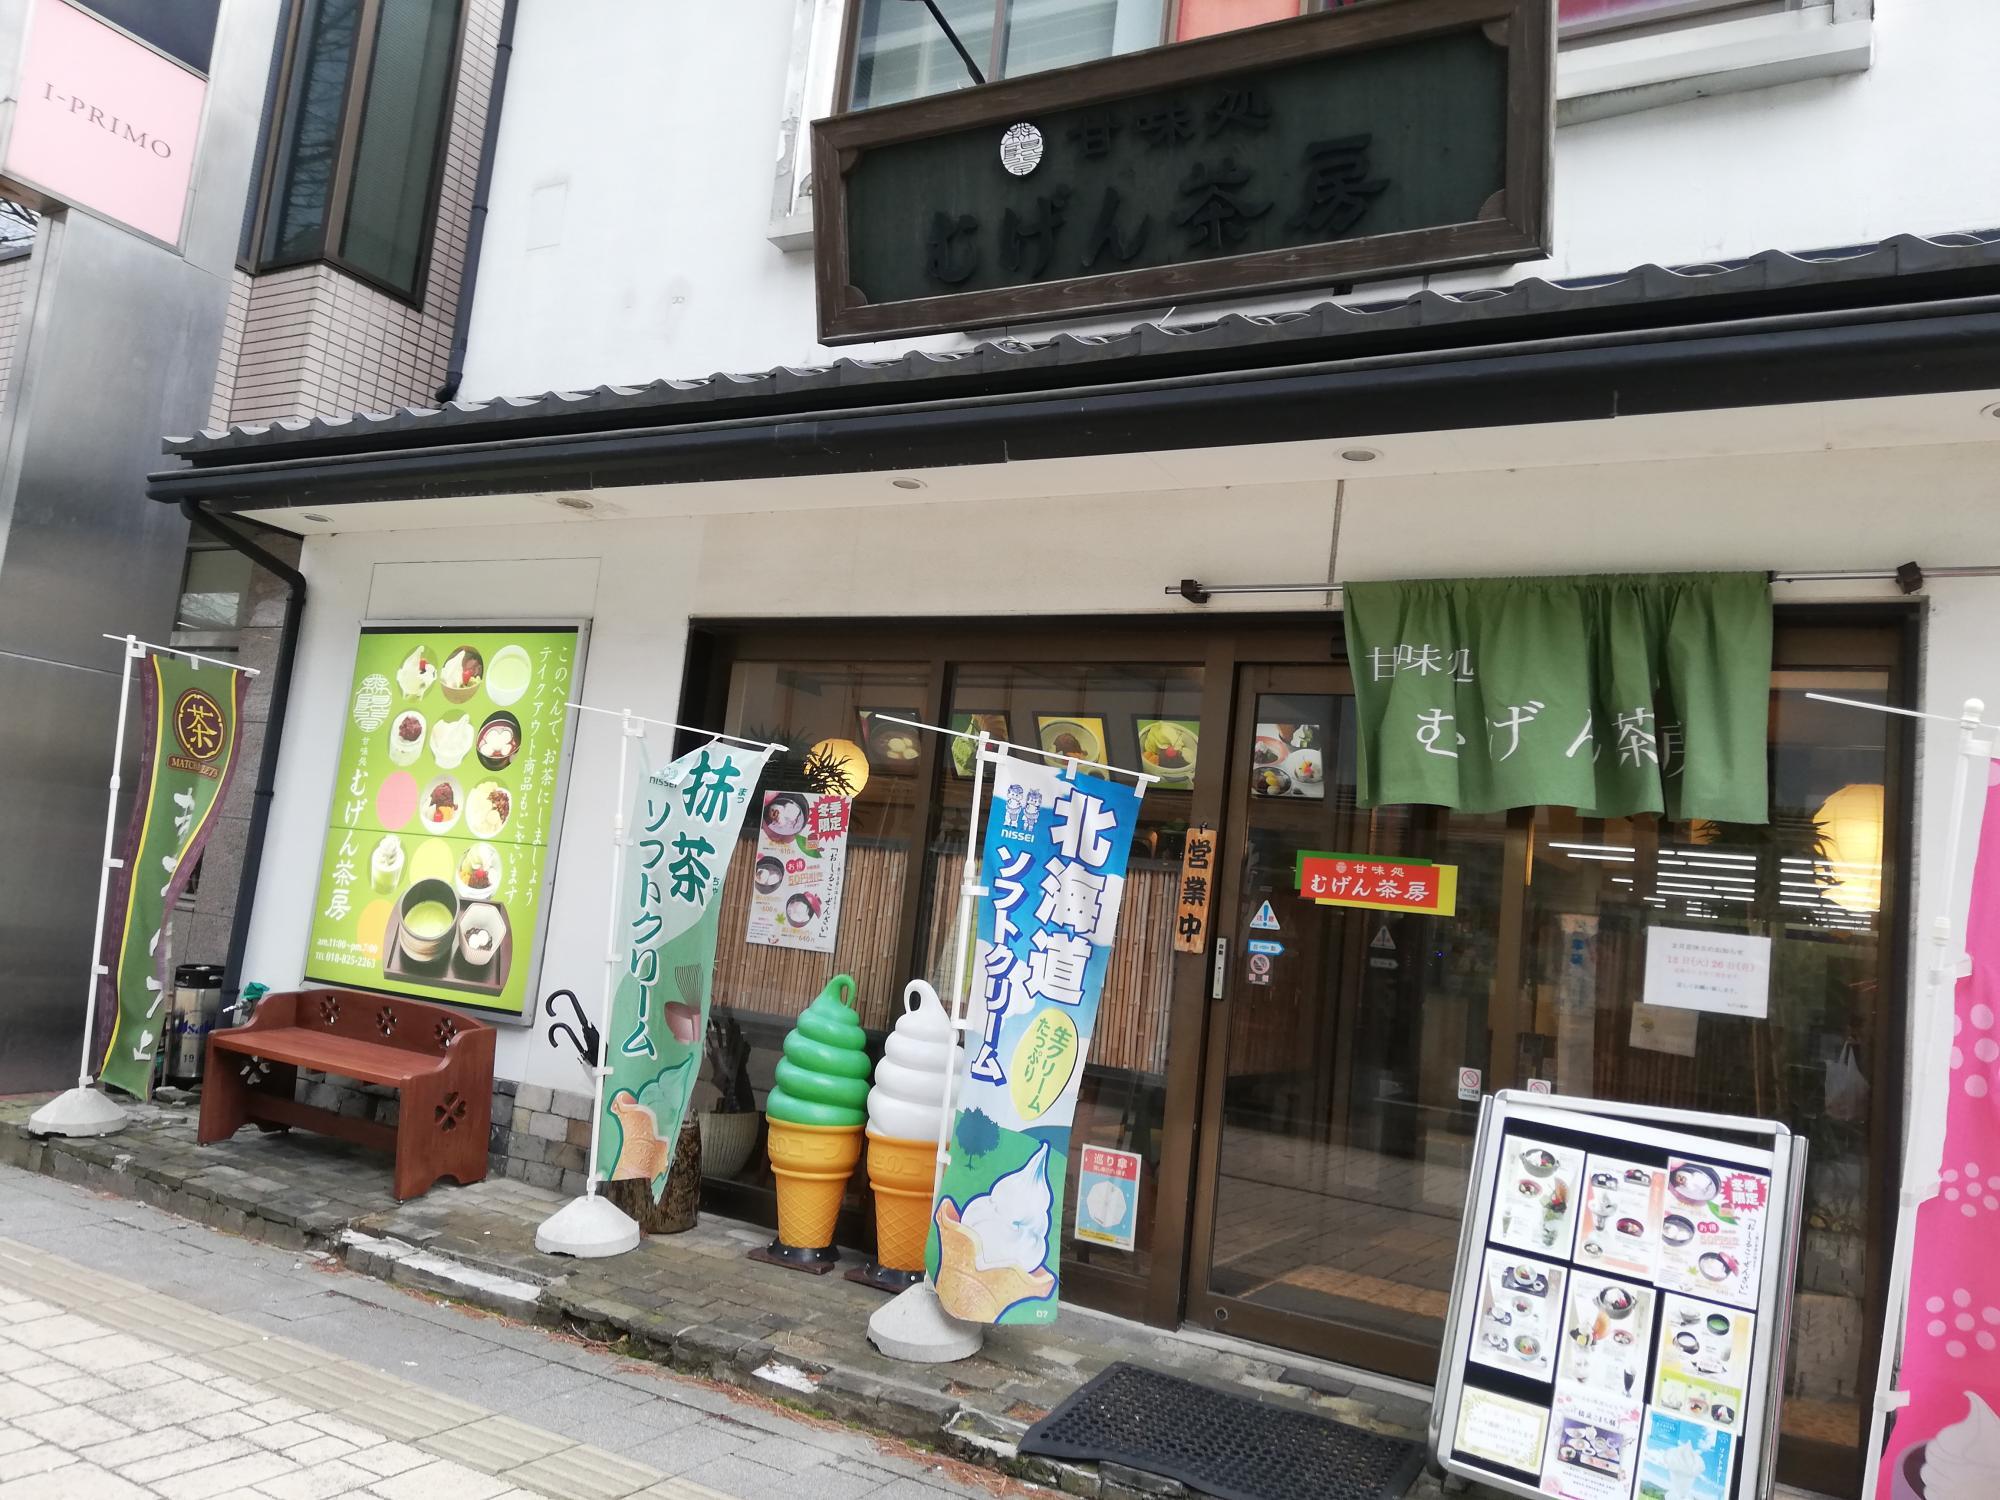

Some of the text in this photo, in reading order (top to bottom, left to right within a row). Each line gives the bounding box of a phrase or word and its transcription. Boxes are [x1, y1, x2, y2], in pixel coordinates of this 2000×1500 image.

[44, 83, 171, 158] I-PRIMO
[1069, 89, 1272, 157] 甘味処
[926, 133, 1390, 283] むげん茶房
[1366, 643, 1474, 683] 甘味処
[186, 704, 217, 748] 茶
[325, 768, 368, 921] むげん茶房
[669, 750, 741, 906] 抹茶
[817, 801, 842, 818] 冬季
[818, 817, 842, 833] 限定
[1000, 828, 1035, 843] NISSEI
[1024, 788, 1118, 1006] 北海道
[1179, 839, 1212, 943] 営業中
[1311, 874, 1430, 902] むげん茶房
[1353, 863, 1405, 878] 甘味処
[620, 799, 671, 1057] ソフトクリーム
[971, 846, 1035, 1086] ソフトクリーム
[1024, 1018, 1050, 1082] たっぷり
[1028, 1026, 1073, 1113] 生クリーム
